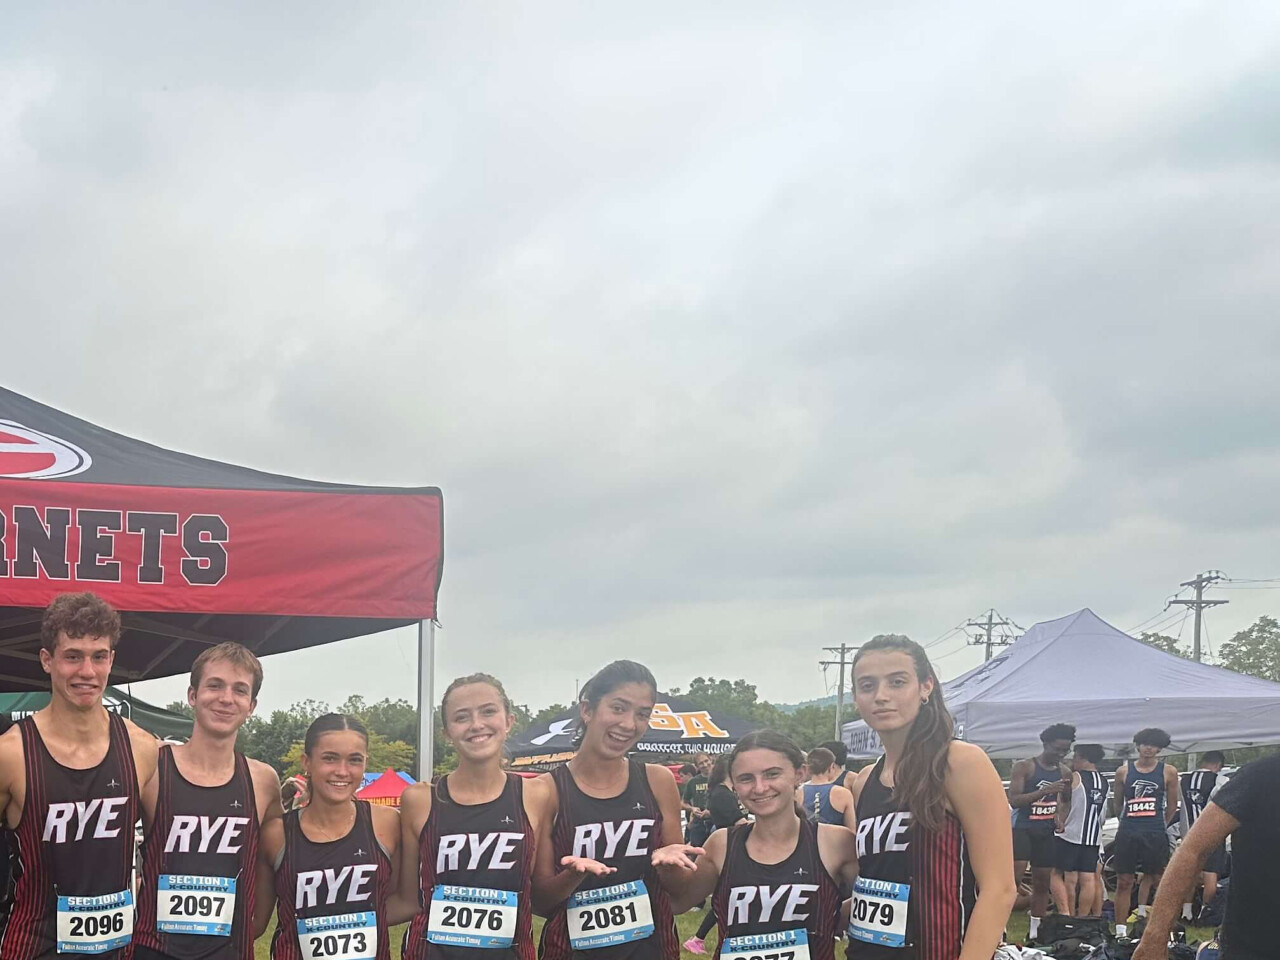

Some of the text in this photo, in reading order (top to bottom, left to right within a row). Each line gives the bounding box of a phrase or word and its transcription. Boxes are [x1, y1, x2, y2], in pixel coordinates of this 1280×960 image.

[1128, 802, 1155, 812] 18442
[42, 797, 128, 843] RYE
[164, 815, 250, 853] RYE
[573, 819, 655, 859] RYE
[856, 812, 911, 859] RYE
[437, 832, 525, 874] RYE
[169, 876, 221, 886] SECTION
[296, 864, 378, 909] RYE
[444, 886, 498, 898] SECTION
[575, 885, 627, 900] SECTION
[68, 895, 118, 905] SECTION
[169, 895, 225, 917] 2097
[727, 884, 820, 926] RYE
[853, 897, 894, 926] 2079
[70, 912, 123, 936] 2096
[305, 914, 357, 927] SECTION
[441, 906, 503, 930] 2076
[579, 902, 637, 931] 2081
[310, 932, 367, 957] 2073
[730, 932, 786, 946] SECTION
